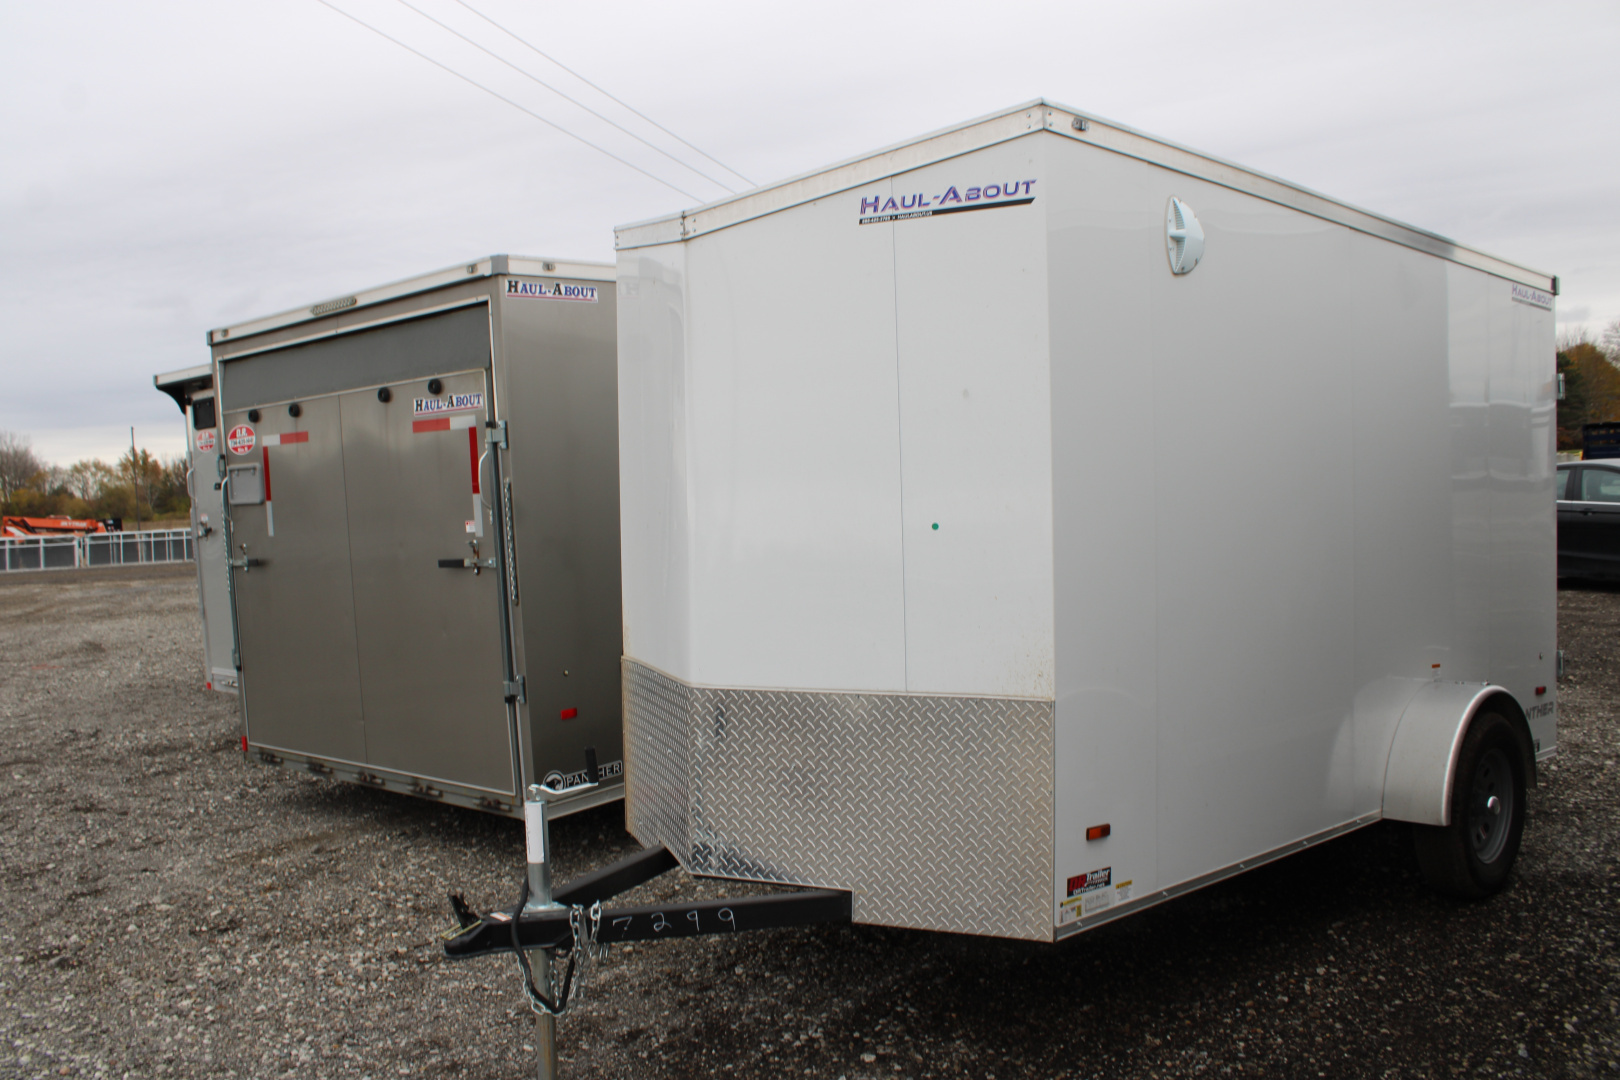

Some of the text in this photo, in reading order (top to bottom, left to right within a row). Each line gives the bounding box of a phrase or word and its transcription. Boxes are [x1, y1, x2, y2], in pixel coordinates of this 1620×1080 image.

[860, 178, 1037, 216] HAUL-ABOUT
[506, 280, 597, 298] HAUL-ABOUT
[1511, 283, 1553, 306] HAUL-ABOUT
[414, 393, 482, 412] HAUL-ABOUT
[1525, 701, 1554, 720] NTHER
[565, 763, 620, 788] PANHER
